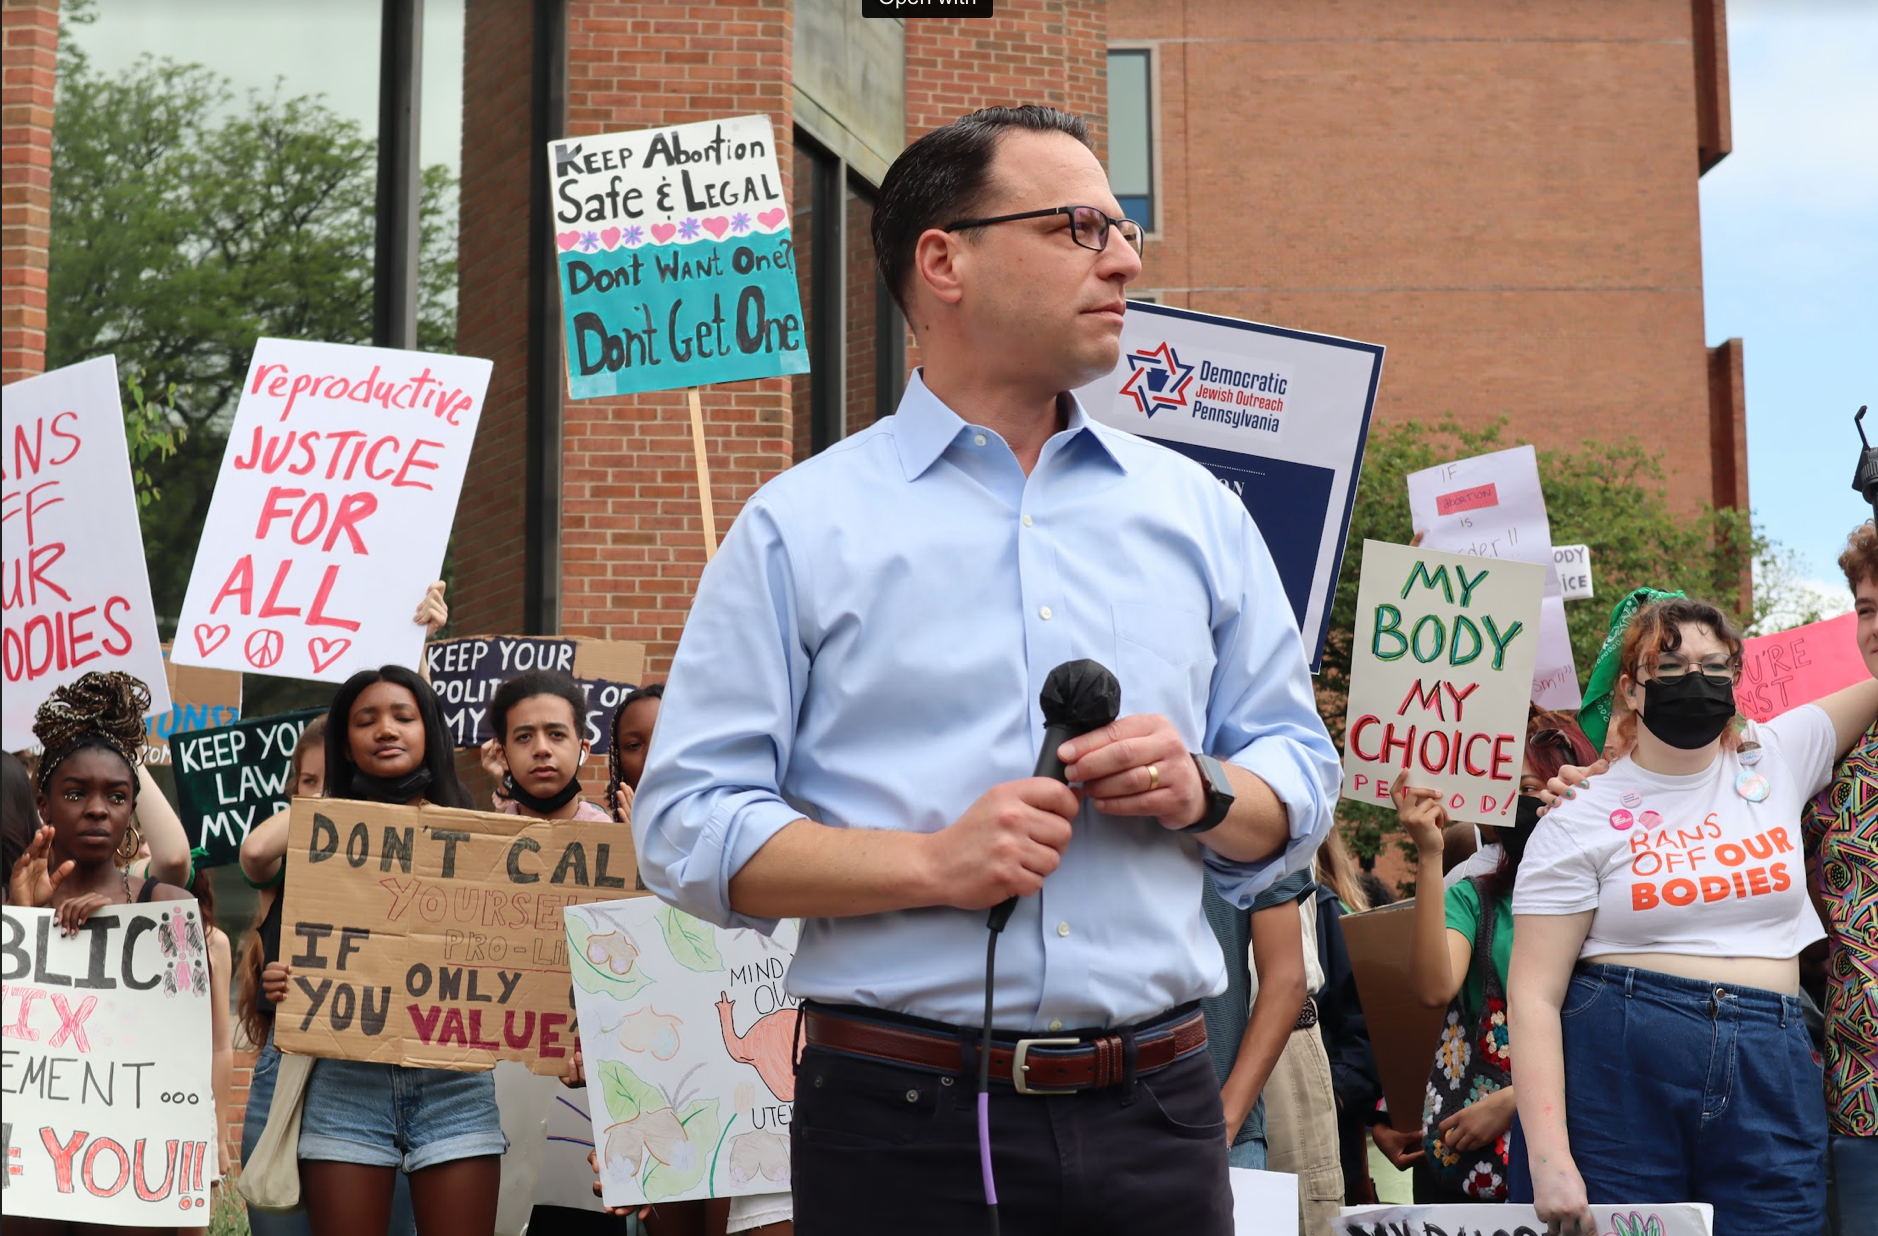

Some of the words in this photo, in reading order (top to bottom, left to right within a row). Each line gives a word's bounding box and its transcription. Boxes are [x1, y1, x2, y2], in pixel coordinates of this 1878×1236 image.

[642, 124, 765, 168] Abortion
[557, 175, 644, 224] Safe
[656, 176, 675, 221] &
[681, 169, 779, 212] LEGAL
[732, 238, 794, 275] One?
[573, 302, 662, 376] Don't
[668, 292, 730, 363] Get
[735, 285, 800, 354] One
[250, 363, 473, 427] reproductive
[1195, 384, 1234, 404] Jewish
[1235, 390, 1284, 412] Outreach
[1199, 360, 1288, 396] Democratic
[1191, 400, 1280, 433] Pennsylvania
[2, 411, 82, 481] NS
[234, 425, 446, 491] JUSTICE
[255, 486, 379, 555] FOR
[1553, 546, 1585, 564] ODY
[209, 554, 361, 632] ALL
[1400, 560, 1490, 608] MY
[3, 595, 133, 682] ODIES
[427, 641, 489, 672] KEEP
[499, 640, 573, 671] YOUR
[1371, 603, 1523, 672] BODY
[432, 678, 503, 704] POLIT
[1396, 678, 1480, 722] MY
[179, 730, 246, 774] KEEP
[1350, 714, 1516, 781] CHOICE
[1354, 773, 1516, 817] PEOD!
[200, 805, 256, 850] MY
[308, 811, 471, 879] DON'T
[506, 836, 649, 891] CAL
[1631, 846, 1707, 877] OFF
[1714, 826, 1795, 867] OUR
[379, 877, 610, 932] YOURSE
[1631, 862, 1792, 912] BODIES
[291, 921, 370, 971] IF
[730, 957, 784, 987] MIND
[2, 984, 98, 1053] IX
[293, 975, 392, 1037] YOU
[405, 962, 523, 1005] ONLY
[38, 1126, 208, 1211] YOU!!
